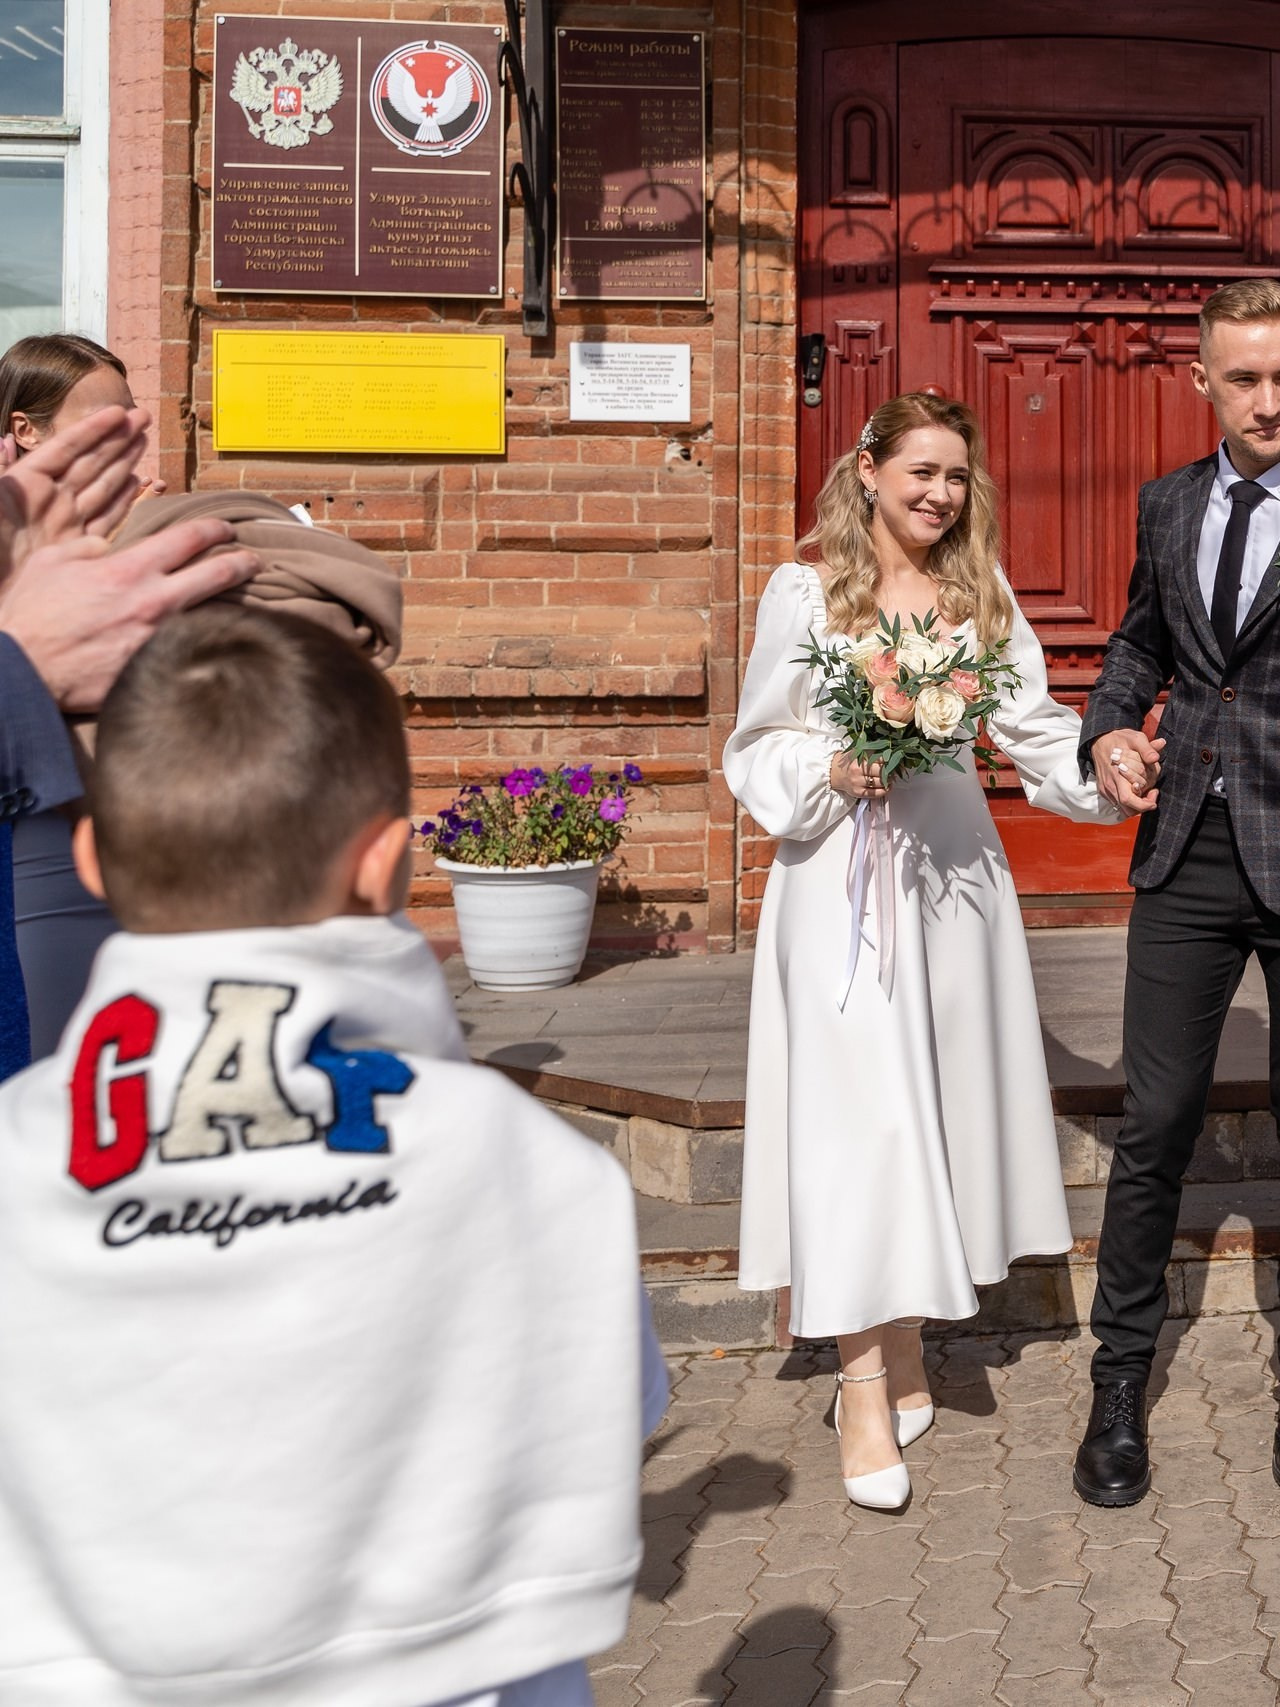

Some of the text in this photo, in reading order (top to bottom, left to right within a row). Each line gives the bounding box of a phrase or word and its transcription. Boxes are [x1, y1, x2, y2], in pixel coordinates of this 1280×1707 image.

[569, 40, 691, 56] Режим работы
[220, 178, 349, 192] Управление записи
[216, 193, 354, 205] актов гражданского
[369, 192, 416, 205] Удмурт
[249, 207, 320, 218] состояния
[603, 205, 658, 216] перерыв
[232, 219, 337, 232] Администрации
[584, 219, 623, 232] 12.00
[638, 220, 677, 232] 12.48
[224, 234, 345, 245] города Воткинска
[246, 246, 324, 259] Удмуртской
[246, 260, 324, 273] Республики
[102, 1179, 398, 1249] California
